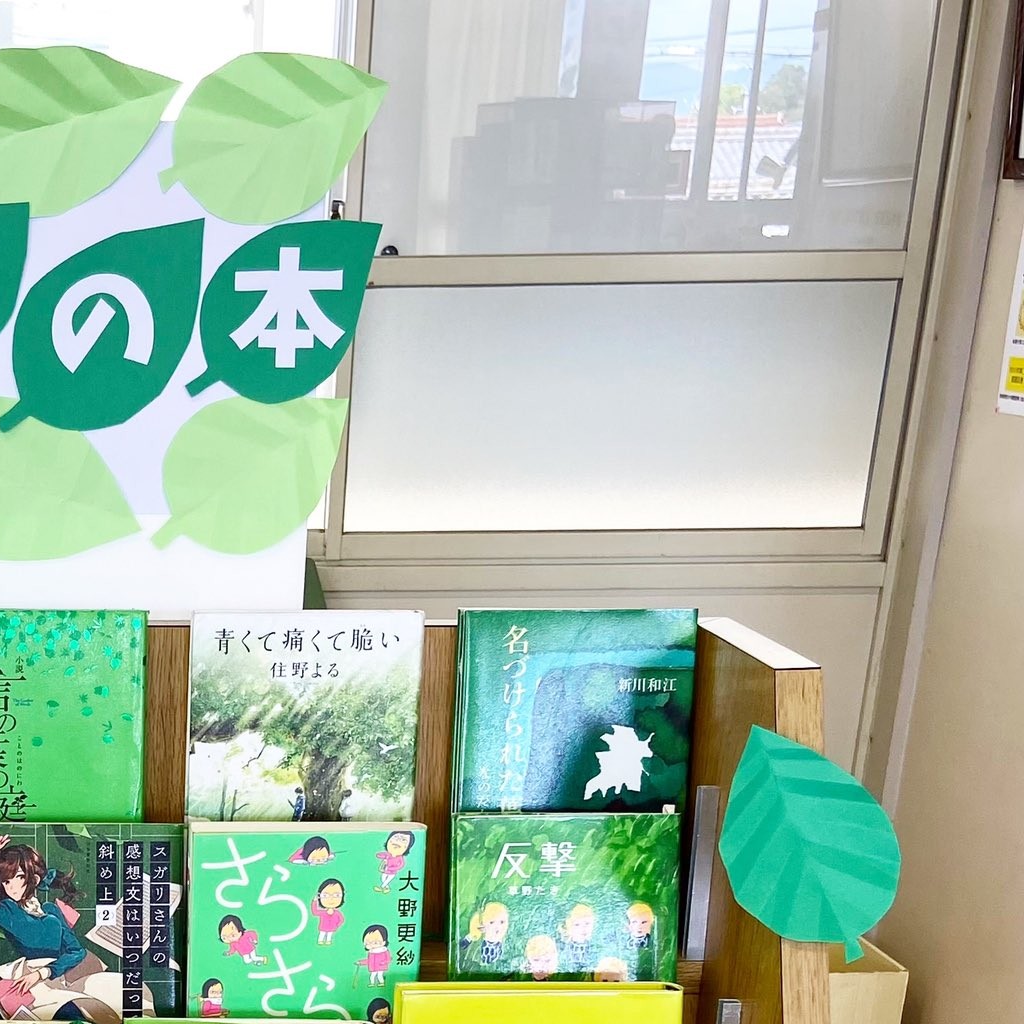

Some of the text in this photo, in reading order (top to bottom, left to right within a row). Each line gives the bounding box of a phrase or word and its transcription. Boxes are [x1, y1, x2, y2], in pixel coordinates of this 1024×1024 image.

[214, 628, 400, 655] 青くて痛くて脆い
[270, 661, 340, 679] 住野よる
[618, 677, 678, 693] 新川和江
[98, 844, 115, 902] 斜め上
[491, 841, 578, 879] 反撃
[152, 845, 169, 964] スガリさんの
[396, 870, 420, 966] 大野更紗
[125, 844, 142, 1018] 感想文はいつだっ
